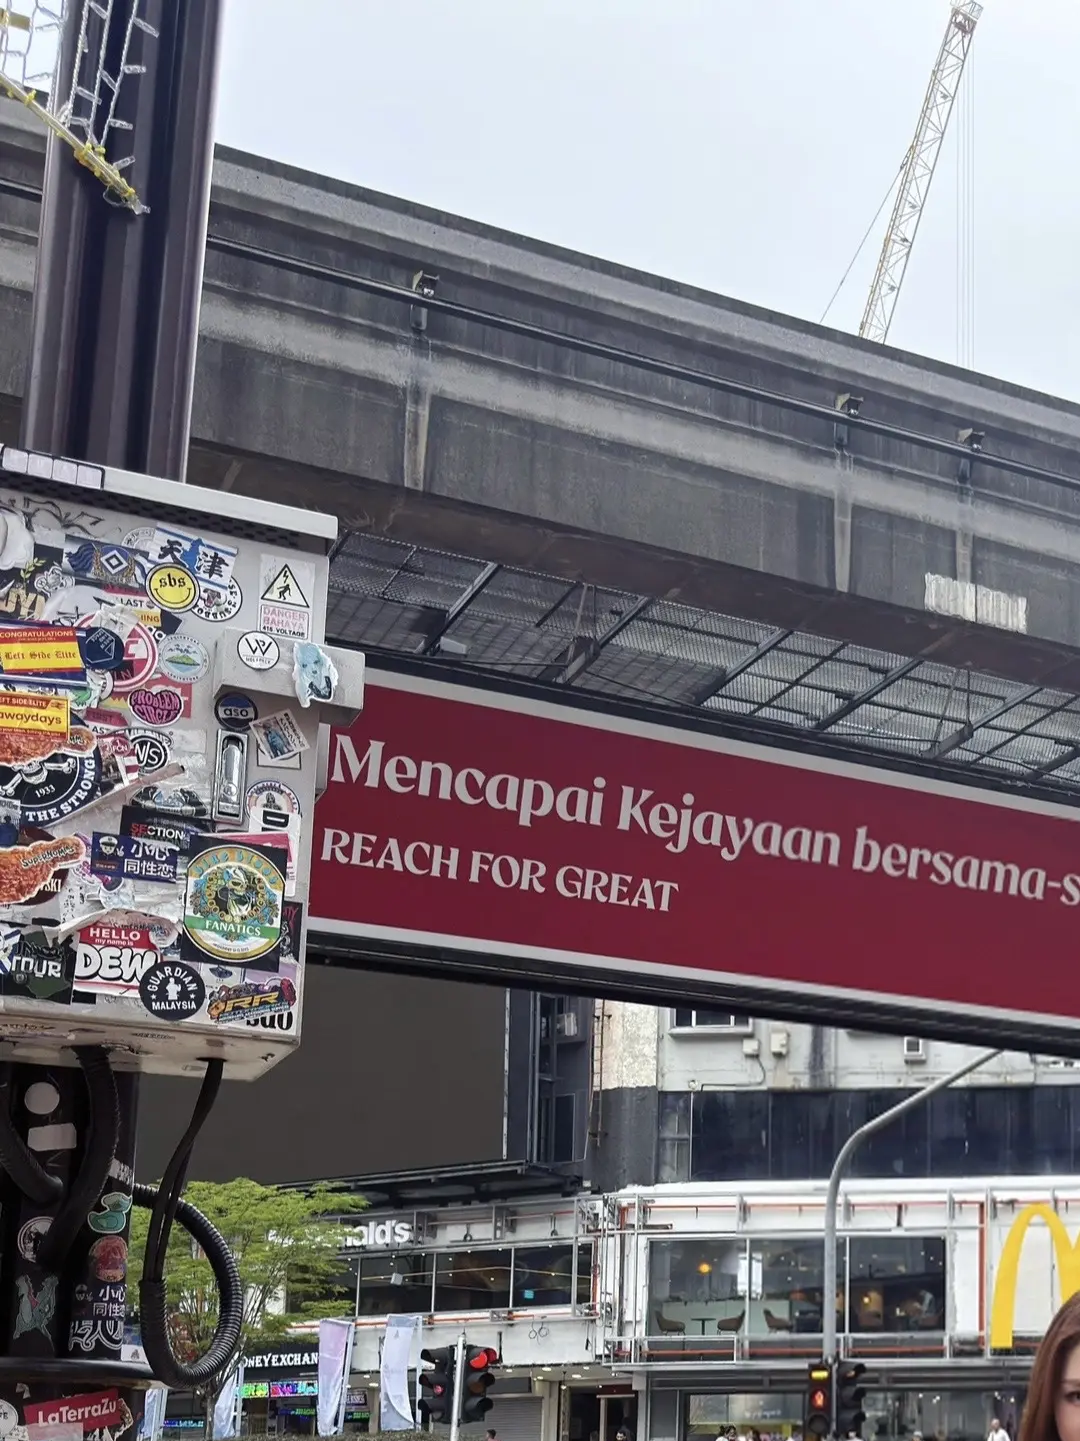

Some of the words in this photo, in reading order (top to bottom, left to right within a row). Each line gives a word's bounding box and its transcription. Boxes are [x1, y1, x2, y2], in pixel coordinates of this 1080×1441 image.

[159, 573, 187, 588] sbs
[262, 607, 306, 621] DANGER
[262, 617, 305, 631] BAHAYA
[0, 630, 74, 639] CONGRATULATIONS
[131, 689, 180, 710] PROBLEM
[0, 711, 62, 727] awaydays
[134, 704, 178, 723] CIRCLE
[223, 708, 249, 718] aso
[26, 807, 60, 822] THE
[61, 757, 97, 814] STRONG
[35, 784, 56, 798] 1933
[331, 733, 606, 828] Mencapai
[617, 783, 841, 866] Kejayaan
[131, 823, 184, 840] SECTION
[124, 858, 174, 878] 同性恋
[320, 827, 460, 880] REACH
[469, 850, 546, 895] FOR
[556, 865, 680, 912] GREAT
[90, 927, 141, 941] HELLO
[205, 920, 261, 937] FANATICS
[147, 966, 198, 992] GUARDIAN
[151, 1000, 197, 1011] MALAYSIA
[346, 1219, 411, 1247] ald's
